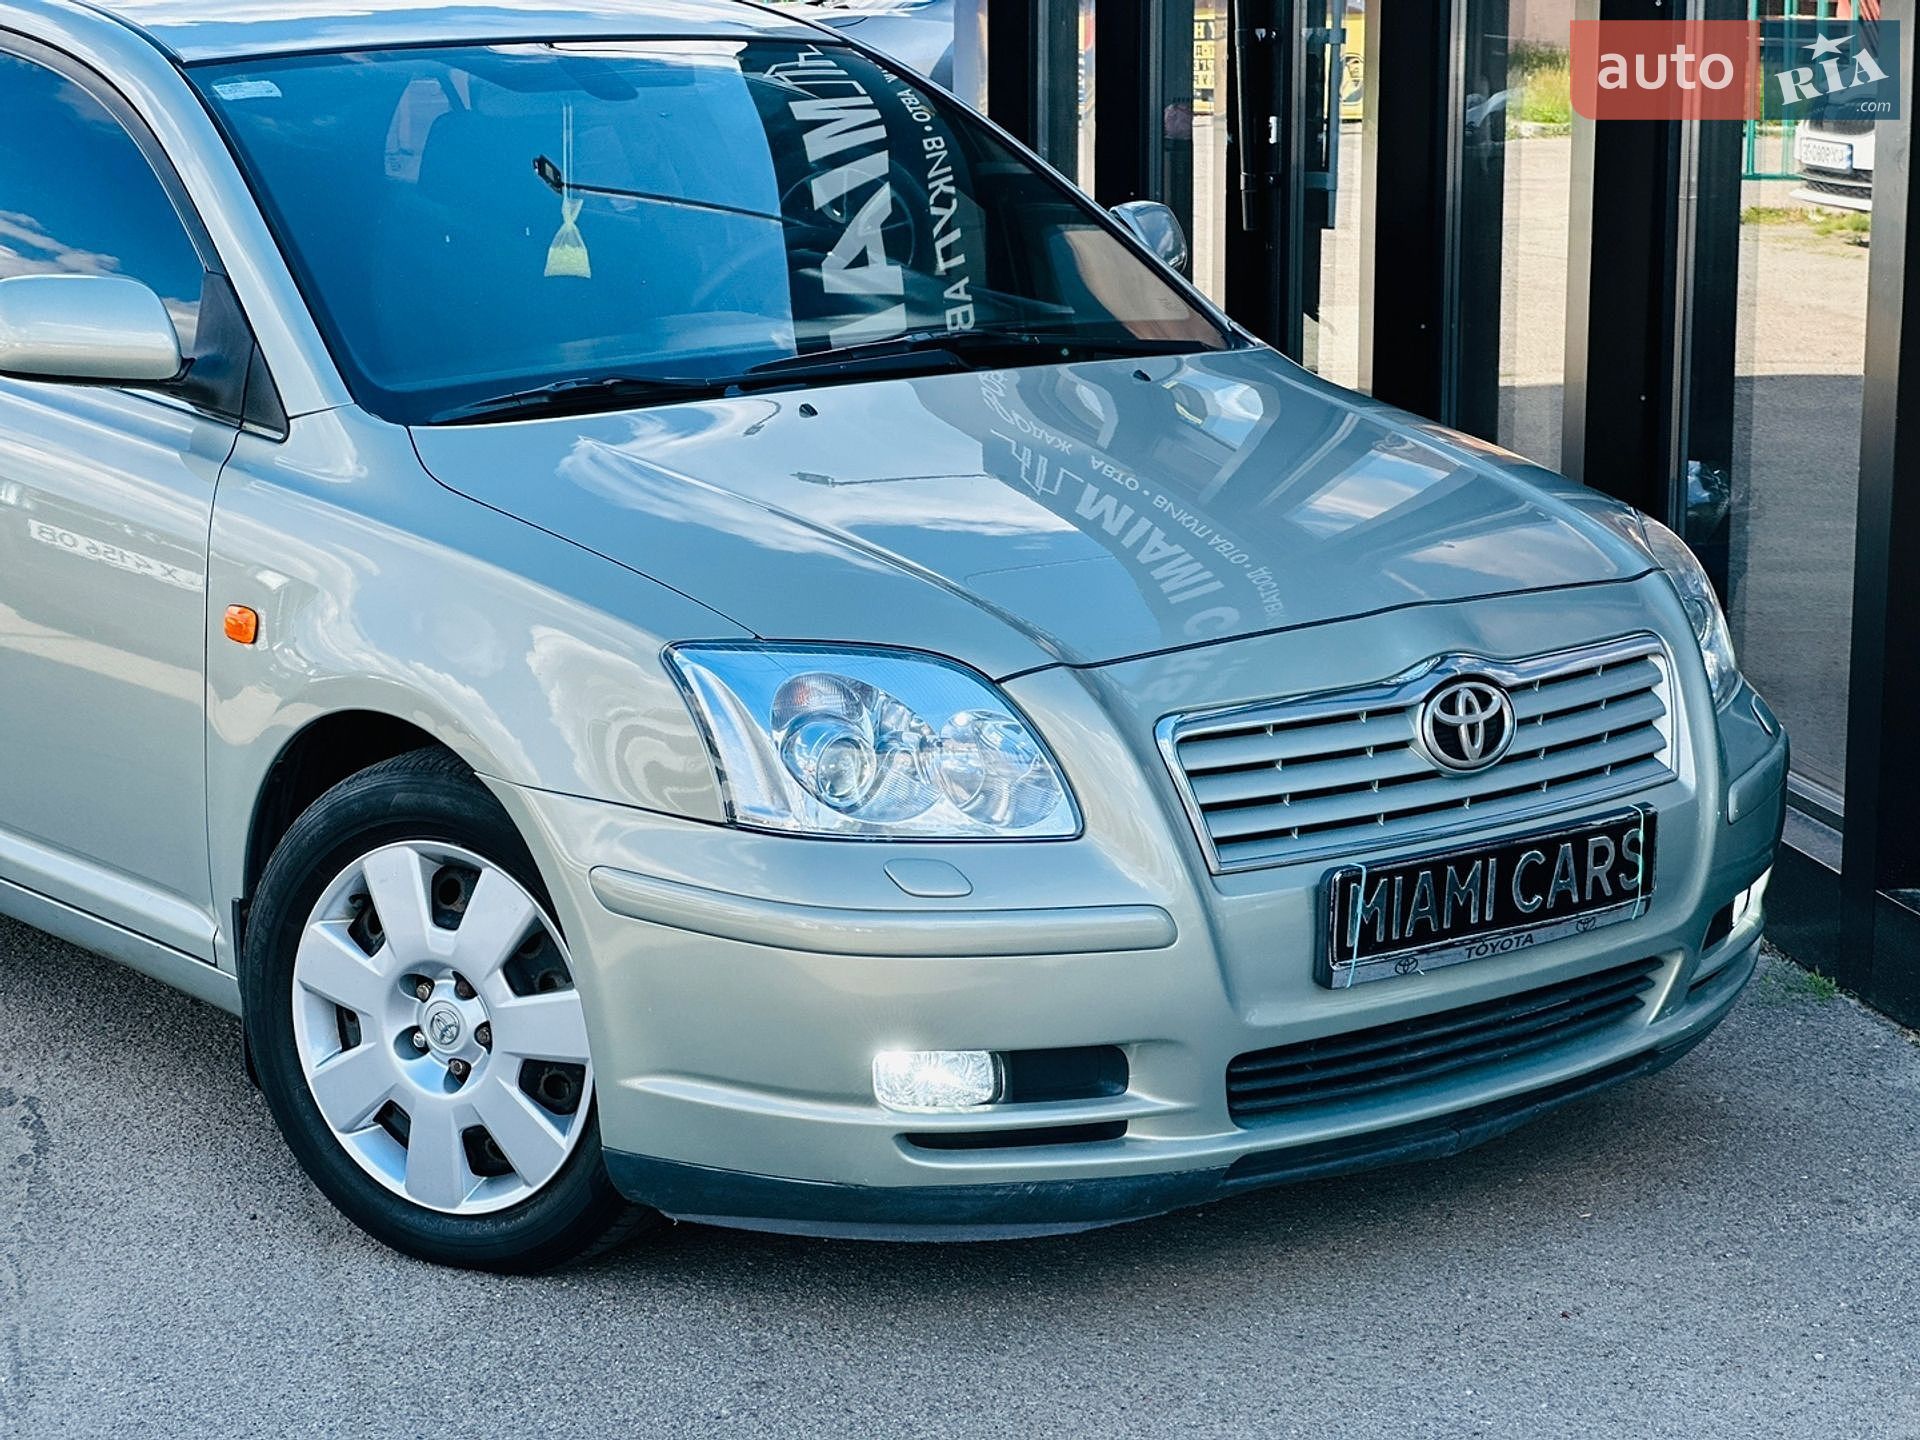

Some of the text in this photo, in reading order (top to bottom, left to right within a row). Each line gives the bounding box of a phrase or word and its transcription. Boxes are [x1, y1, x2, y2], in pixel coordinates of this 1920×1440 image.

[1346, 826, 1644, 948] MIAMI CARS
[1464, 933, 1535, 960] TOYOTA
